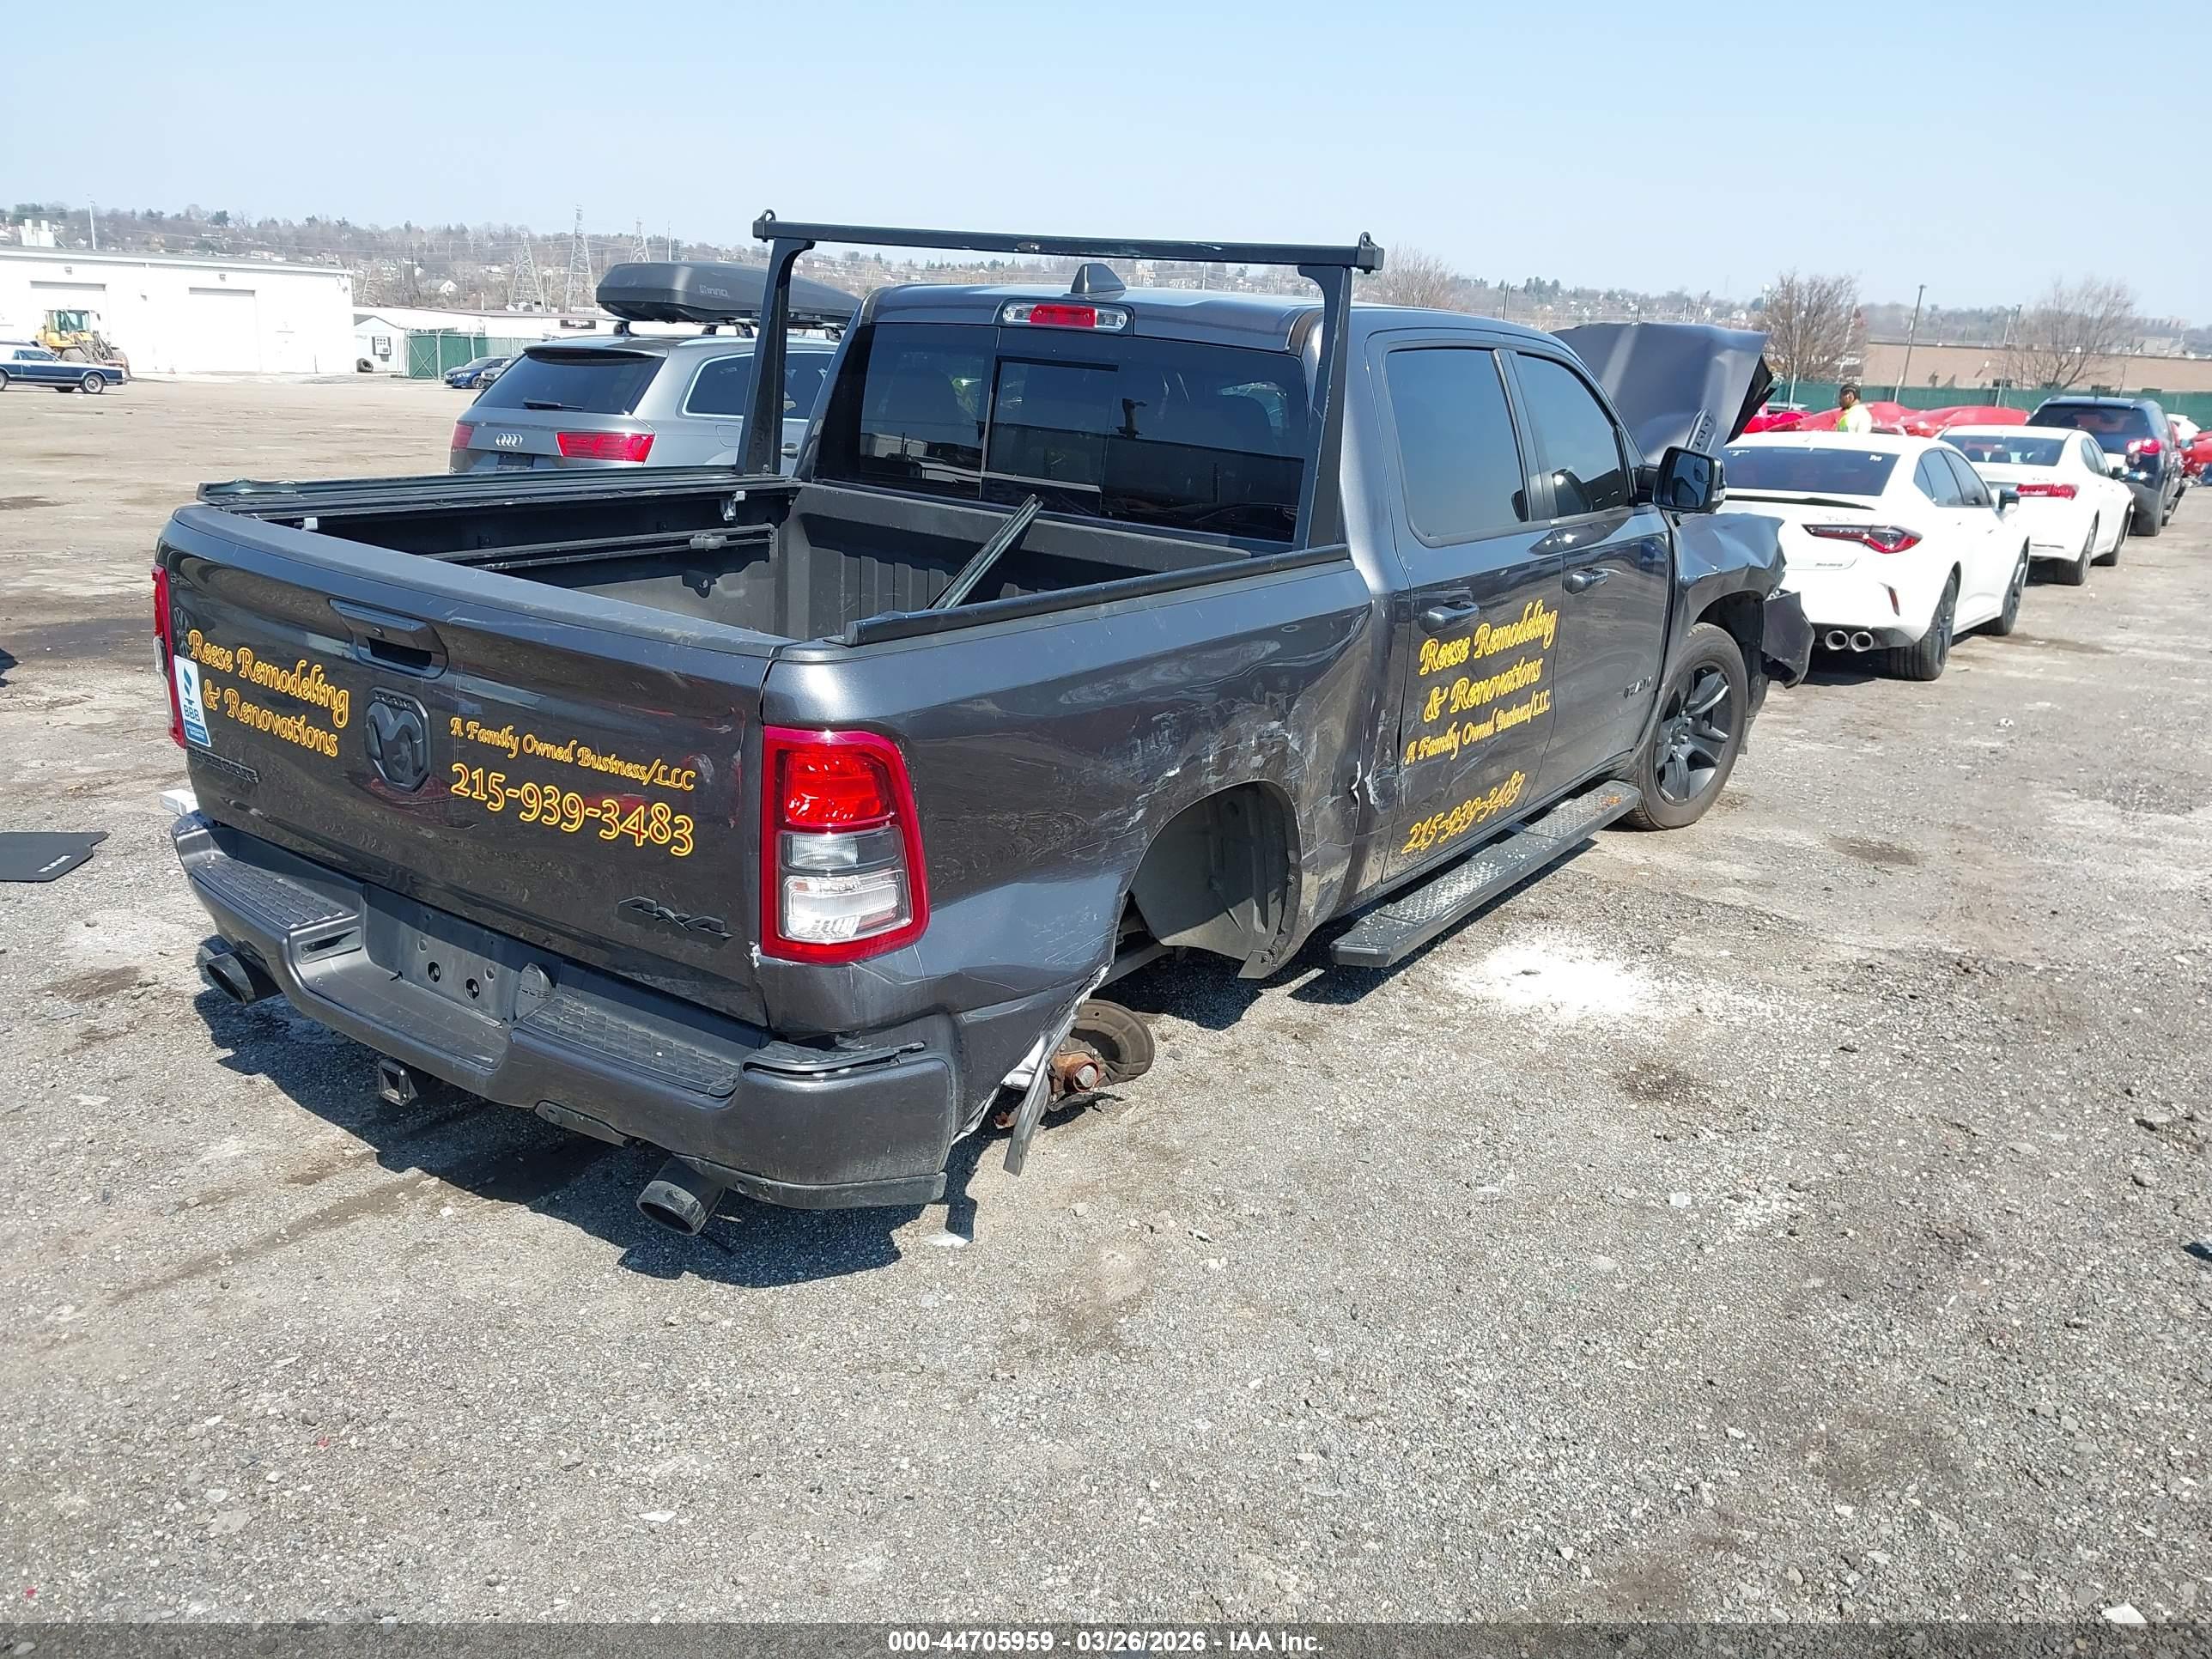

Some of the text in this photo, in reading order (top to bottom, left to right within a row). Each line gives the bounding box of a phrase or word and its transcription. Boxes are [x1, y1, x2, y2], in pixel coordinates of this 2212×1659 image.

[1419, 599, 1558, 676] Reese Remodeling
[183, 704, 201, 722] BBB
[188, 629, 349, 729] Reese Remodeling
[1423, 658, 1544, 723] & Renovations
[203, 679, 338, 757] & Renovations
[450, 717, 696, 791] A Family Owned Business/LLC
[1418, 721, 1460, 760] Family
[1462, 708, 1497, 745] Owned
[451, 763, 694, 857] 215-939-3483
[1401, 770, 1527, 854] 215-939-3483
